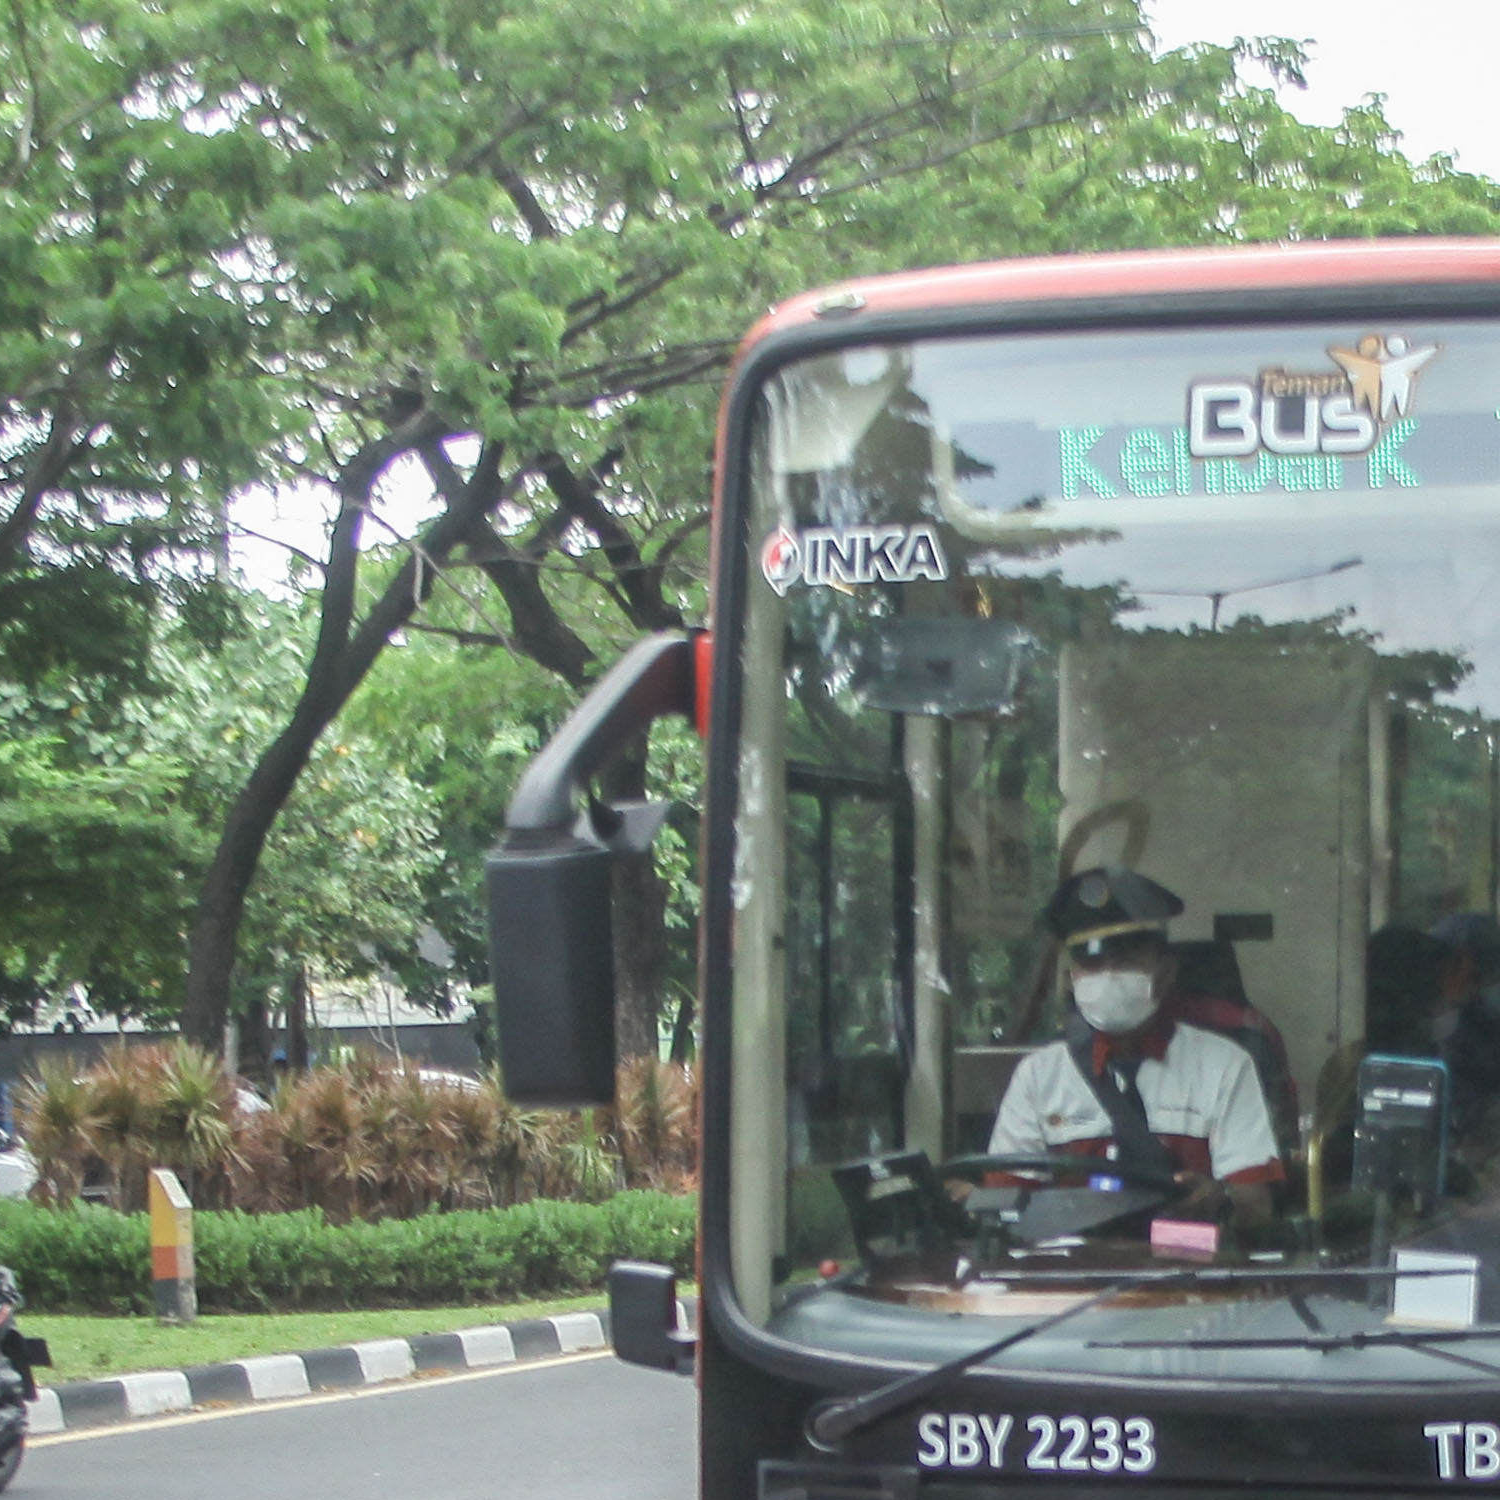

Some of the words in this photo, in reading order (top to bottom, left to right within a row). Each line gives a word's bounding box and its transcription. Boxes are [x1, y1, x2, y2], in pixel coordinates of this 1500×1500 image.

[803, 523, 949, 585] INKA
[918, 1412, 1014, 1468] SBY
[1025, 1414, 1156, 1473] 2233
